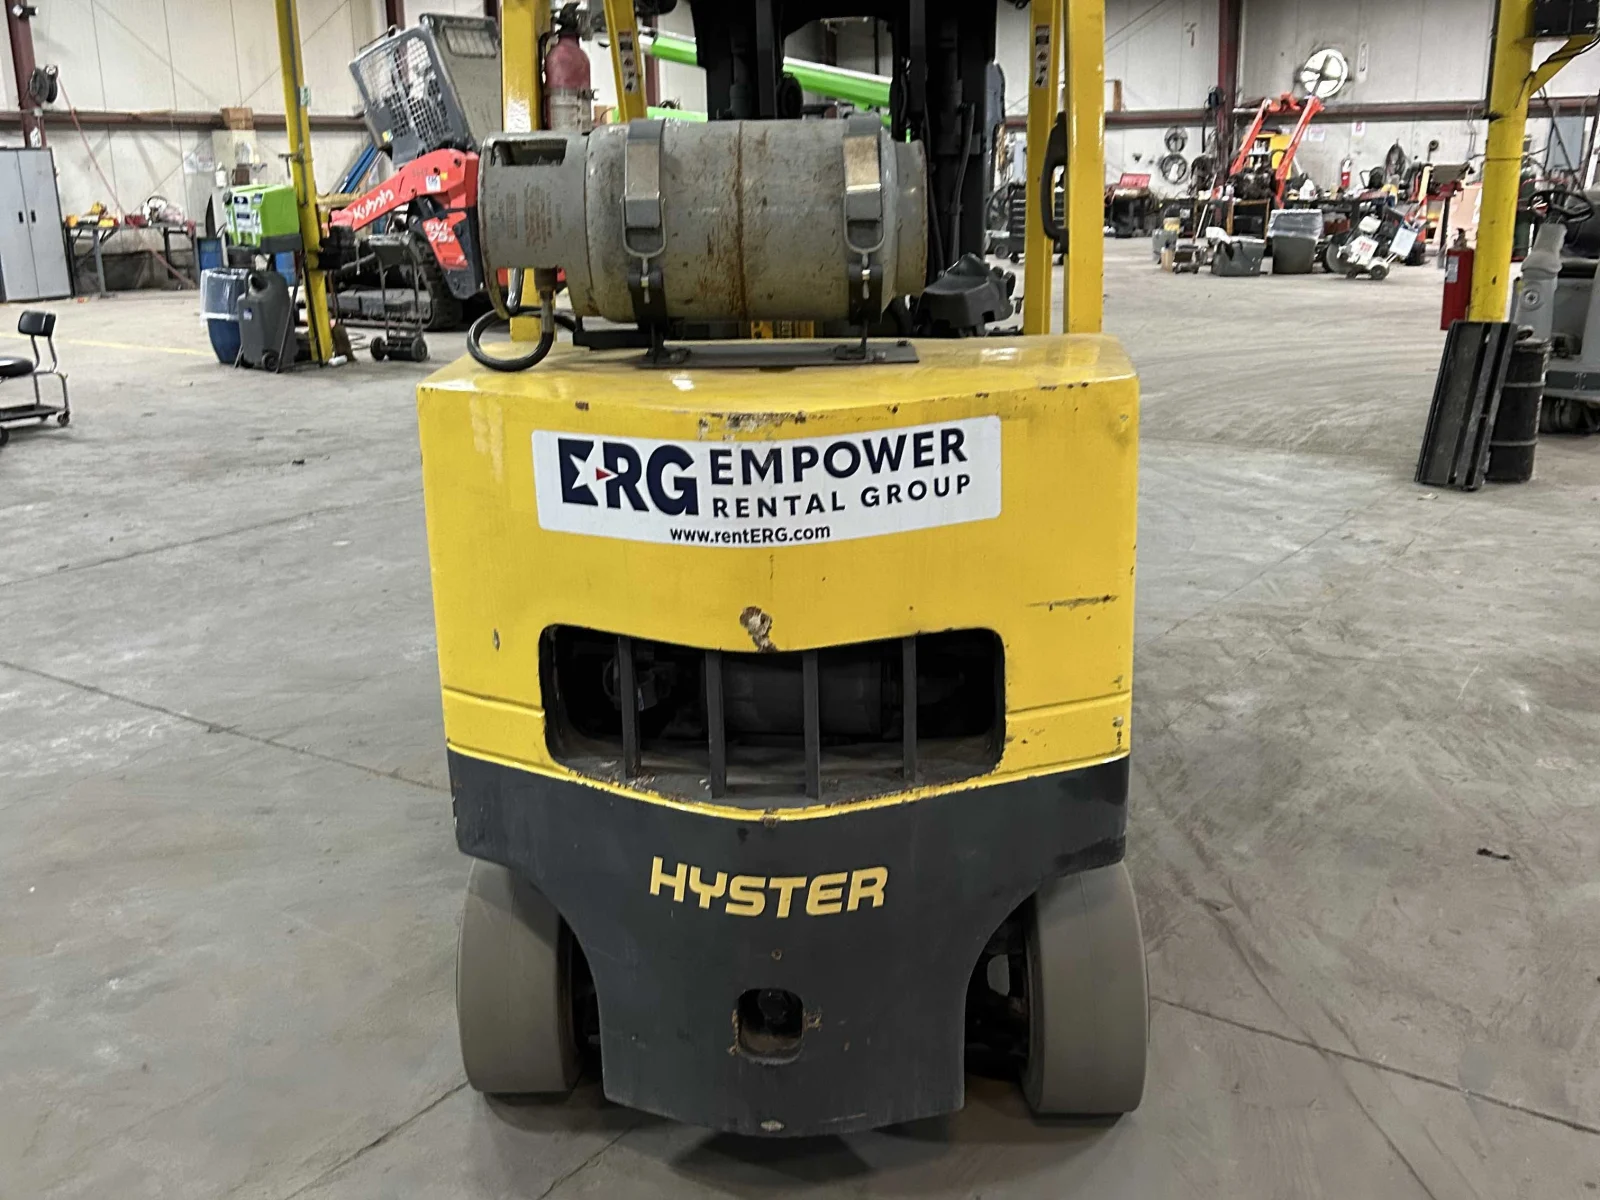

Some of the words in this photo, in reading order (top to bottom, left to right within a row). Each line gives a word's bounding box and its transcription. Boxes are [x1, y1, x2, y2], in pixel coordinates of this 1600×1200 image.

[353, 189, 394, 219] Kubota
[558, 437, 700, 517] ERG
[709, 428, 968, 486] EMPOWER
[712, 490, 846, 519] RENTAL
[860, 474, 971, 508] GROUP
[669, 526, 831, 544] www.rentERG.com
[650, 856, 888, 918] HYSTER
